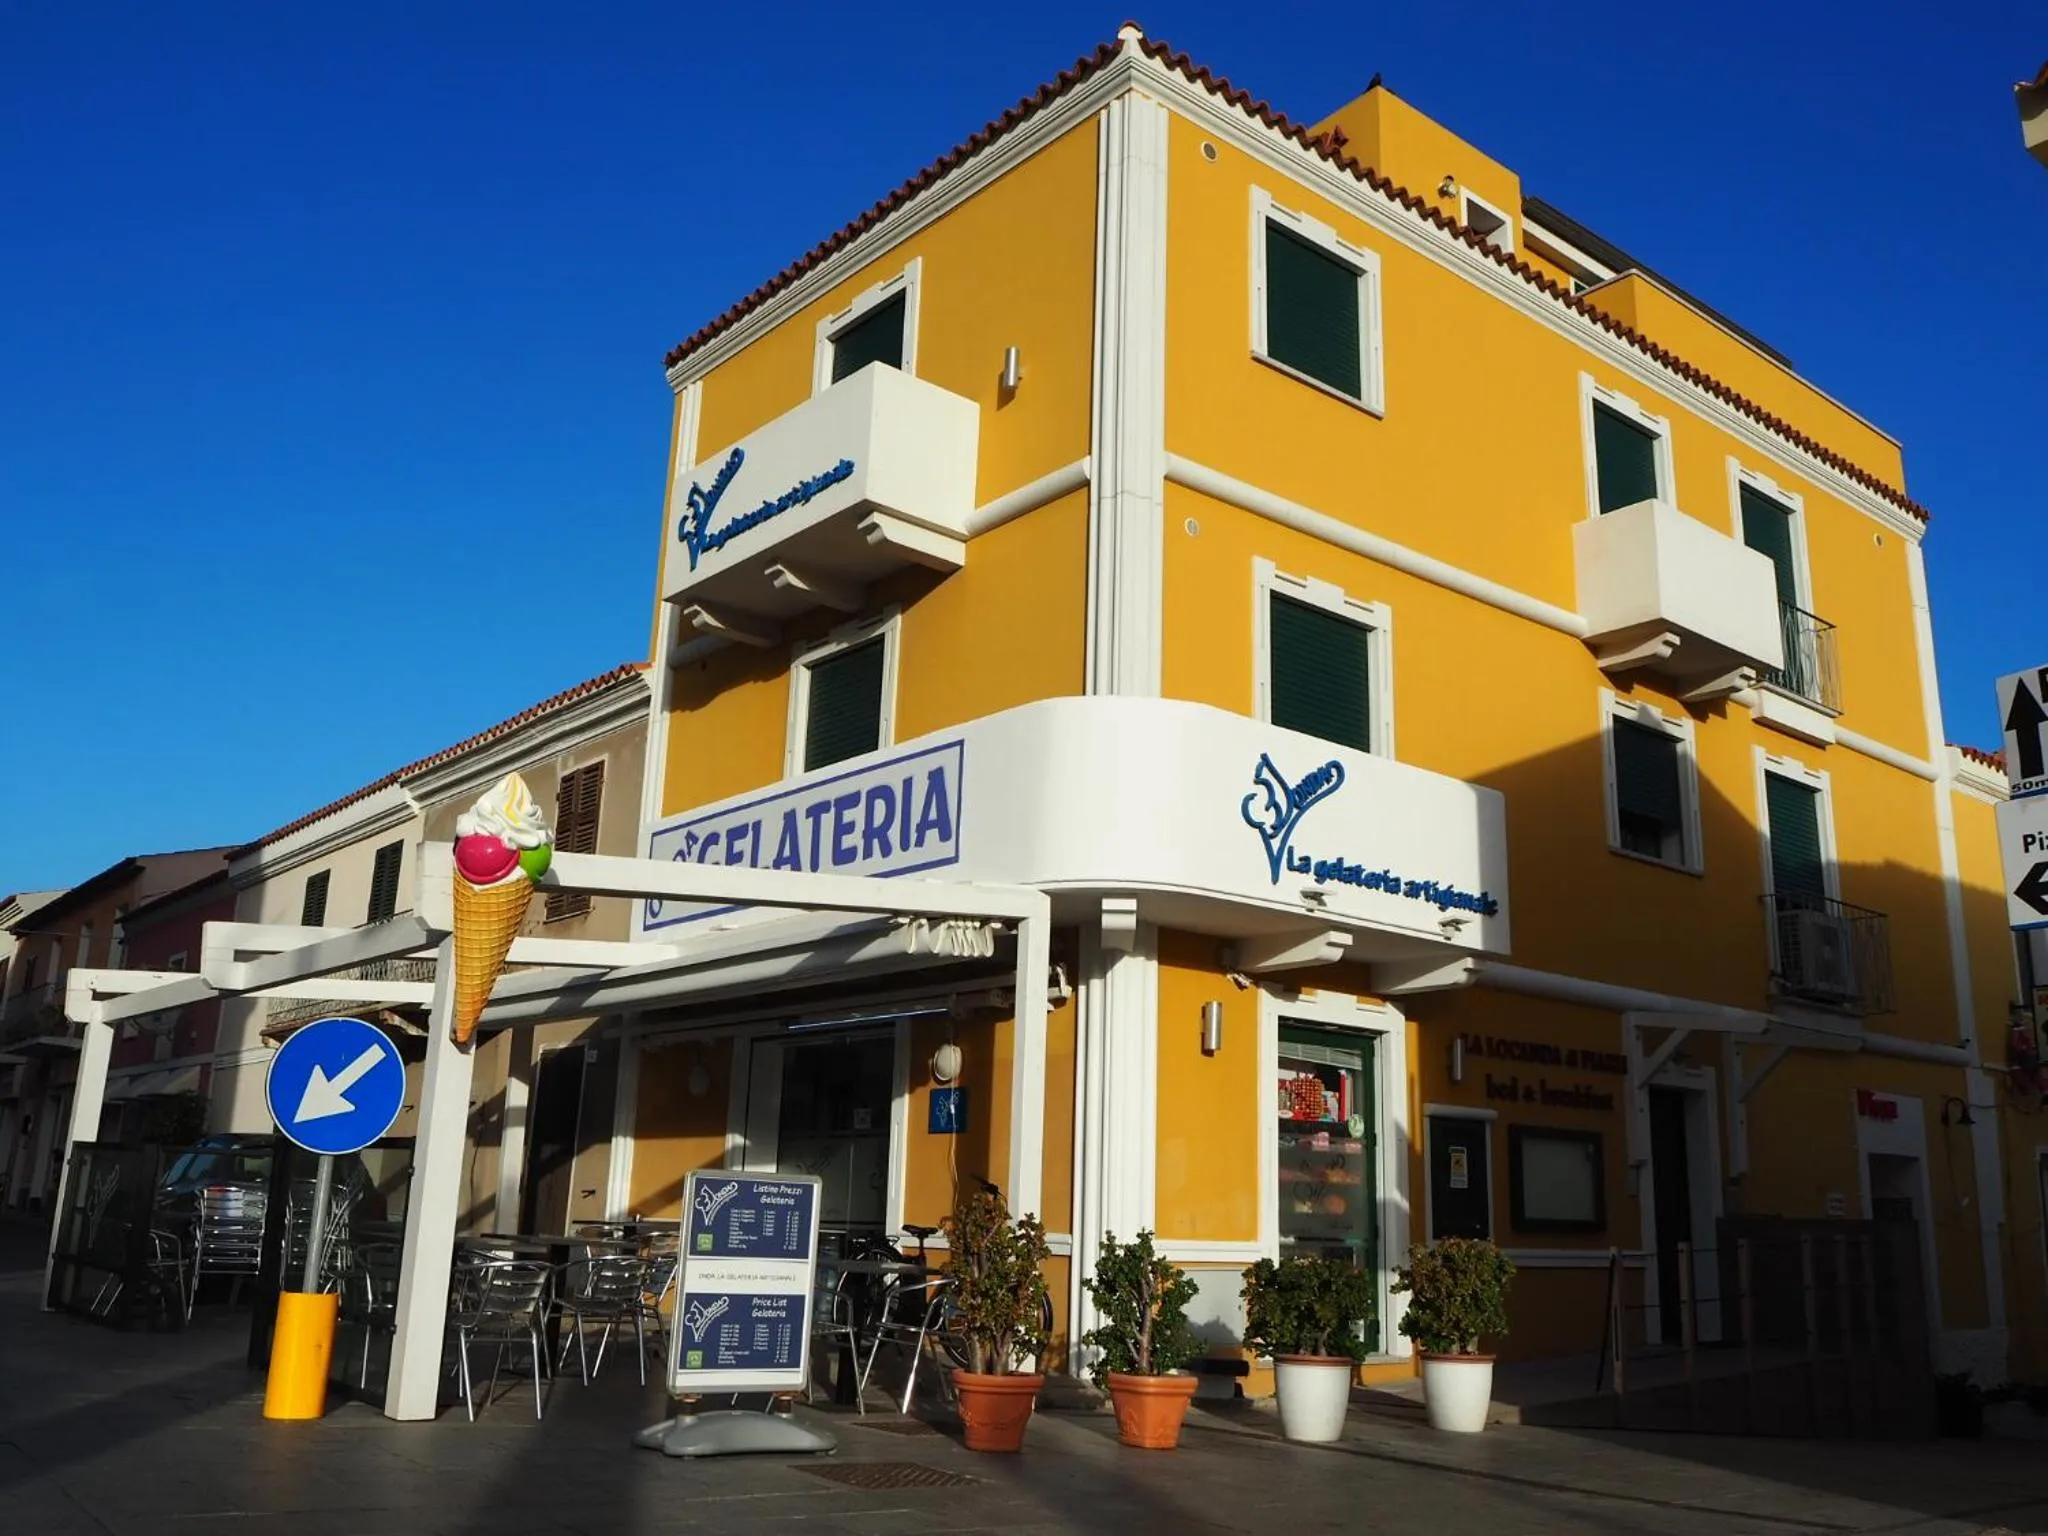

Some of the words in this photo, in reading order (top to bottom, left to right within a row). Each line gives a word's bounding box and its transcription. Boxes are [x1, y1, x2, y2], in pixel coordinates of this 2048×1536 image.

[697, 766, 953, 873] GELATERIA
[1287, 845, 1311, 874] La
[1314, 857, 1401, 894] gelateria
[753, 1183, 779, 1194] Listino
[760, 1195, 795, 1206] Gelateria
[752, 1297, 771, 1307] Price
[773, 1298, 787, 1307] List
[751, 1308, 786, 1318] Gelateria
